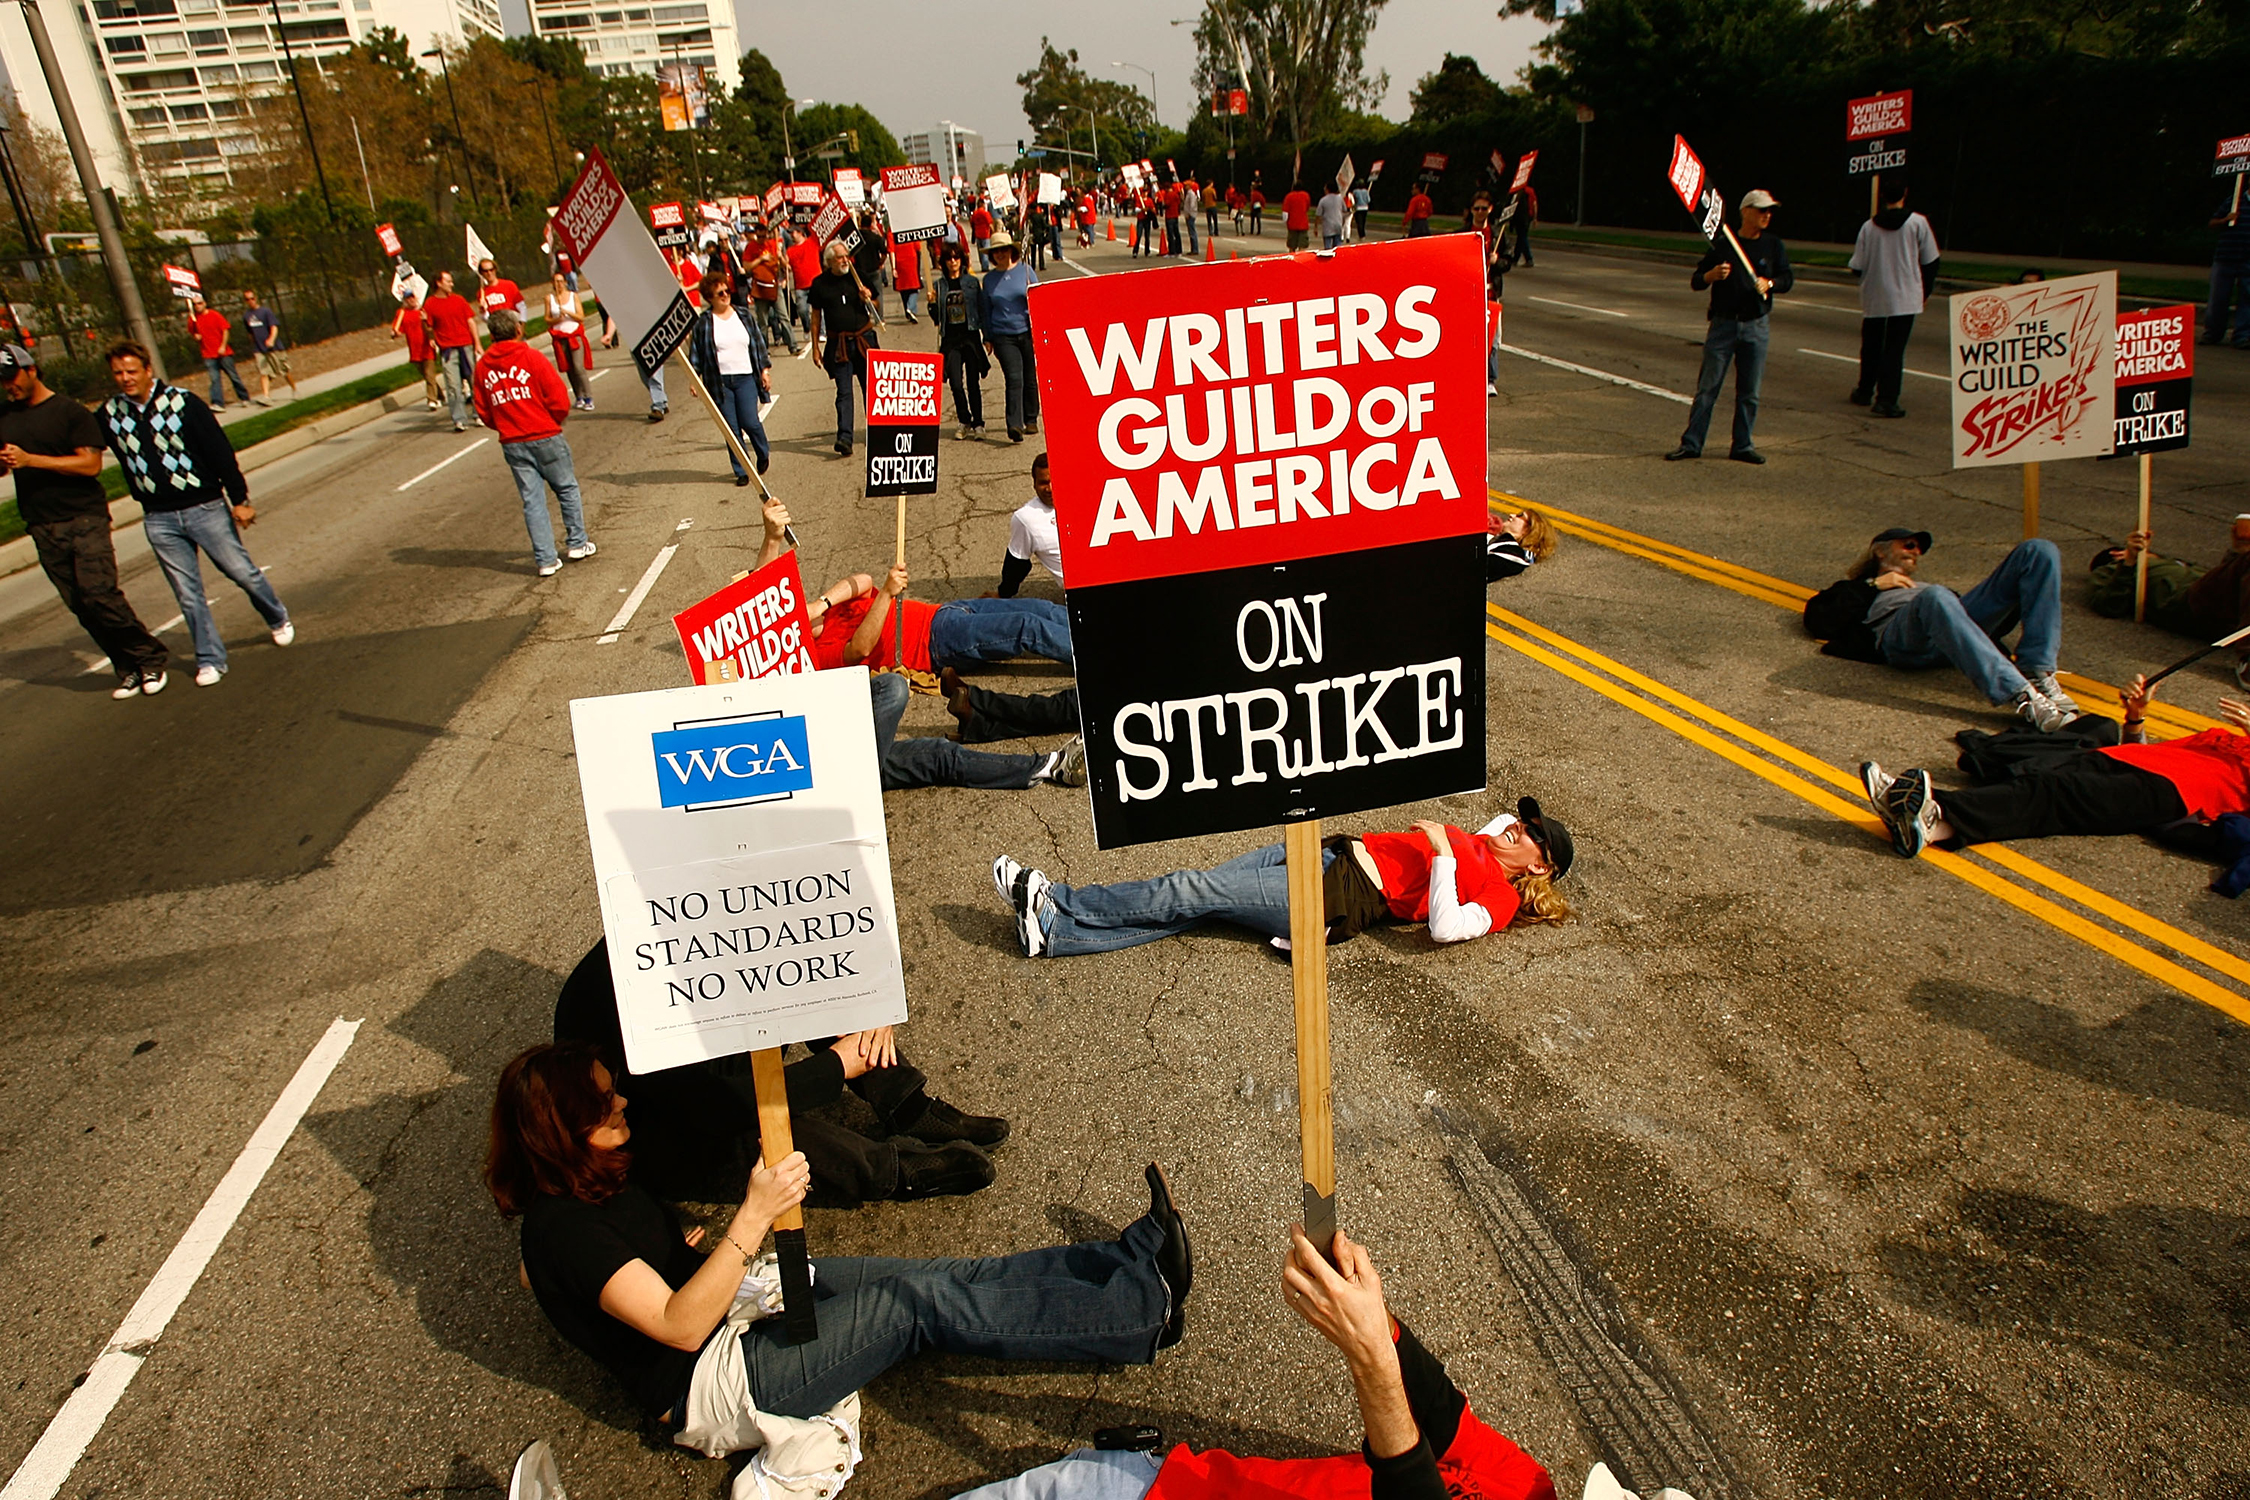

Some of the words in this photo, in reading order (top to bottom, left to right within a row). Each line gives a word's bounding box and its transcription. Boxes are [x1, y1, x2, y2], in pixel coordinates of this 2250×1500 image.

[1852, 97, 1904, 116] WRITERS
[1854, 110, 1890, 126] GUILD
[1851, 118, 1906, 136] AMERICA
[1848, 149, 1906, 174] STRIKE
[1869, 140, 1885, 153] ON
[886, 166, 932, 177] WRITERS
[888, 177, 935, 190] AMERICA
[559, 160, 602, 228] WRITERS
[569, 190, 600, 240] GUILD
[575, 188, 619, 256] AMERICA
[897, 226, 945, 243] STRIKE
[640, 299, 692, 369] STRIKE
[1066, 285, 1442, 397] WRITERS
[2015, 320, 2049, 335] THE
[1959, 332, 2067, 366] WRITERS
[2163, 339, 2182, 354] OF
[873, 361, 936, 381] WRITERS
[1958, 364, 2040, 393] GUILD
[2115, 352, 2186, 379] MERICA
[875, 379, 920, 398] GUILD
[920, 386, 934, 399] OF
[2132, 390, 2156, 413] ON
[872, 398, 937, 416] AMERICA
[1097, 377, 1352, 470] GUILD
[1357, 381, 1435, 438] OF
[2114, 409, 2186, 446] TRIKE
[895, 433, 913, 453] ON
[871, 455, 935, 486] STRIKE
[1089, 437, 1461, 548] AMERICA
[691, 577, 796, 663] WRITERS
[1236, 592, 1328, 673] ON
[728, 629, 782, 679] UILD
[781, 620, 801, 654] OF
[1113, 656, 1465, 803] STRIKE
[661, 738, 804, 785] WGA
[645, 892, 709, 926] NO
[718, 869, 852, 916] UNION
[635, 906, 875, 971] STANDARDS
[664, 972, 726, 1007] NO
[735, 950, 860, 994] WORK
